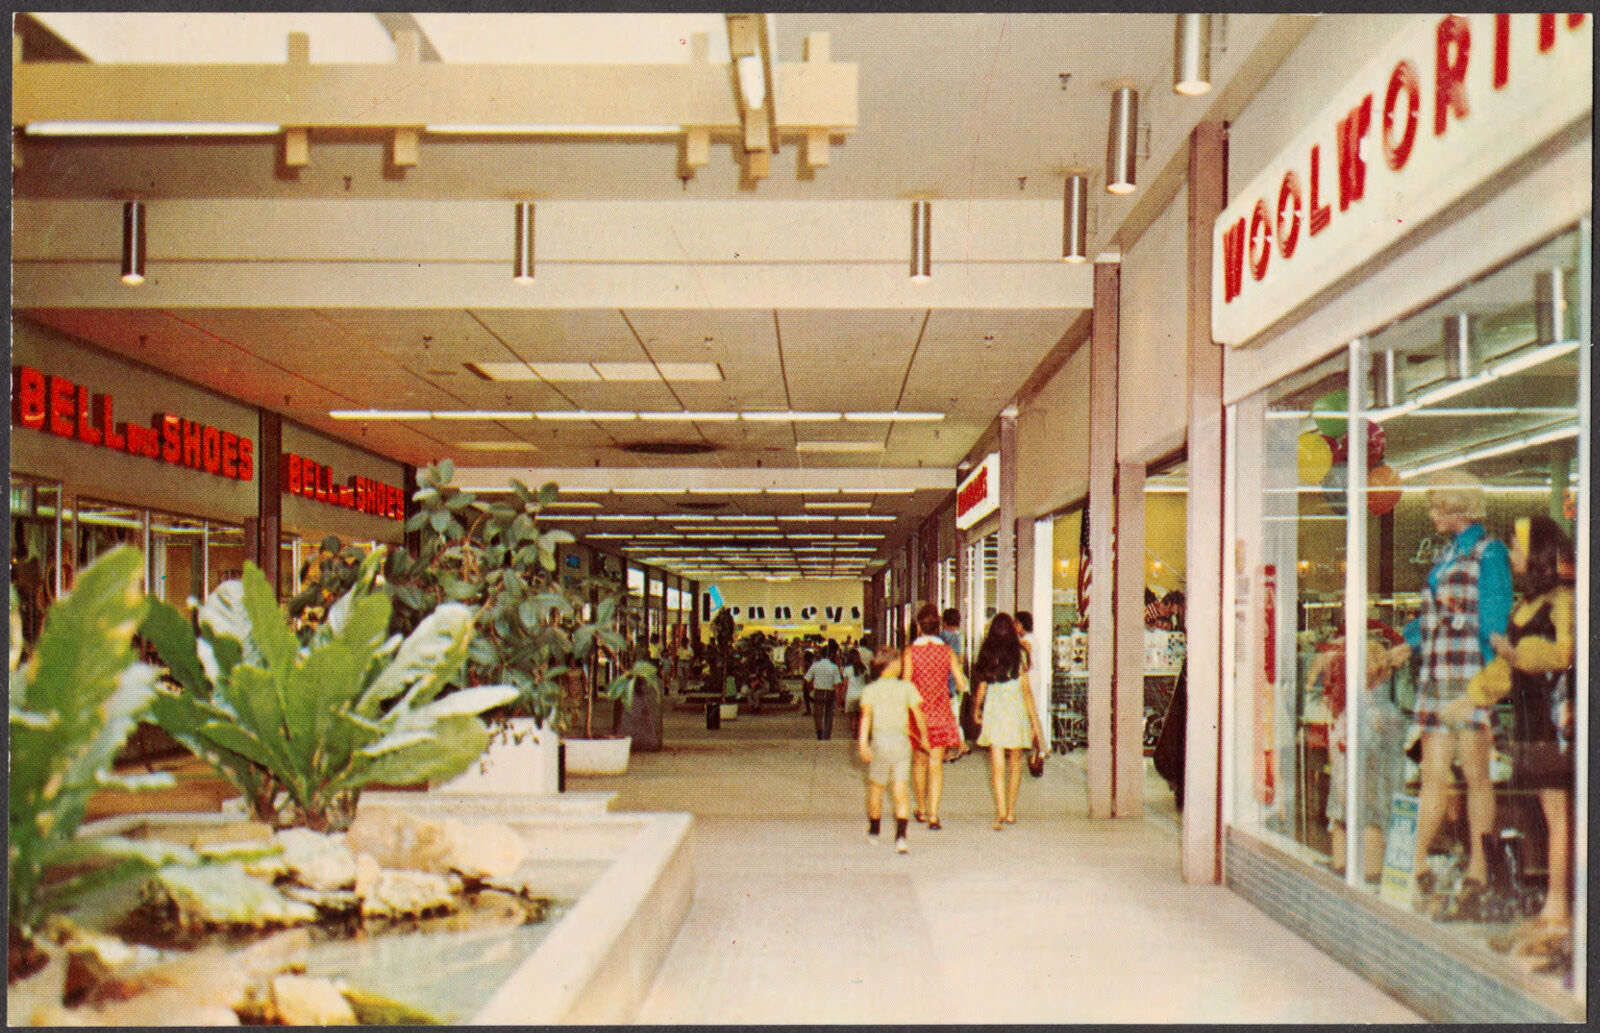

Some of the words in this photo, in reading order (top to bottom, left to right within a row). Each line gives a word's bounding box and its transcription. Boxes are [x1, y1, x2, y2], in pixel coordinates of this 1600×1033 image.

[1222, 13, 1584, 303] WOOLWORT
[19, 366, 125, 450] BELL
[162, 412, 253, 482] SHOES
[288, 452, 339, 505] BELL
[356, 475, 404, 522] SHOES
